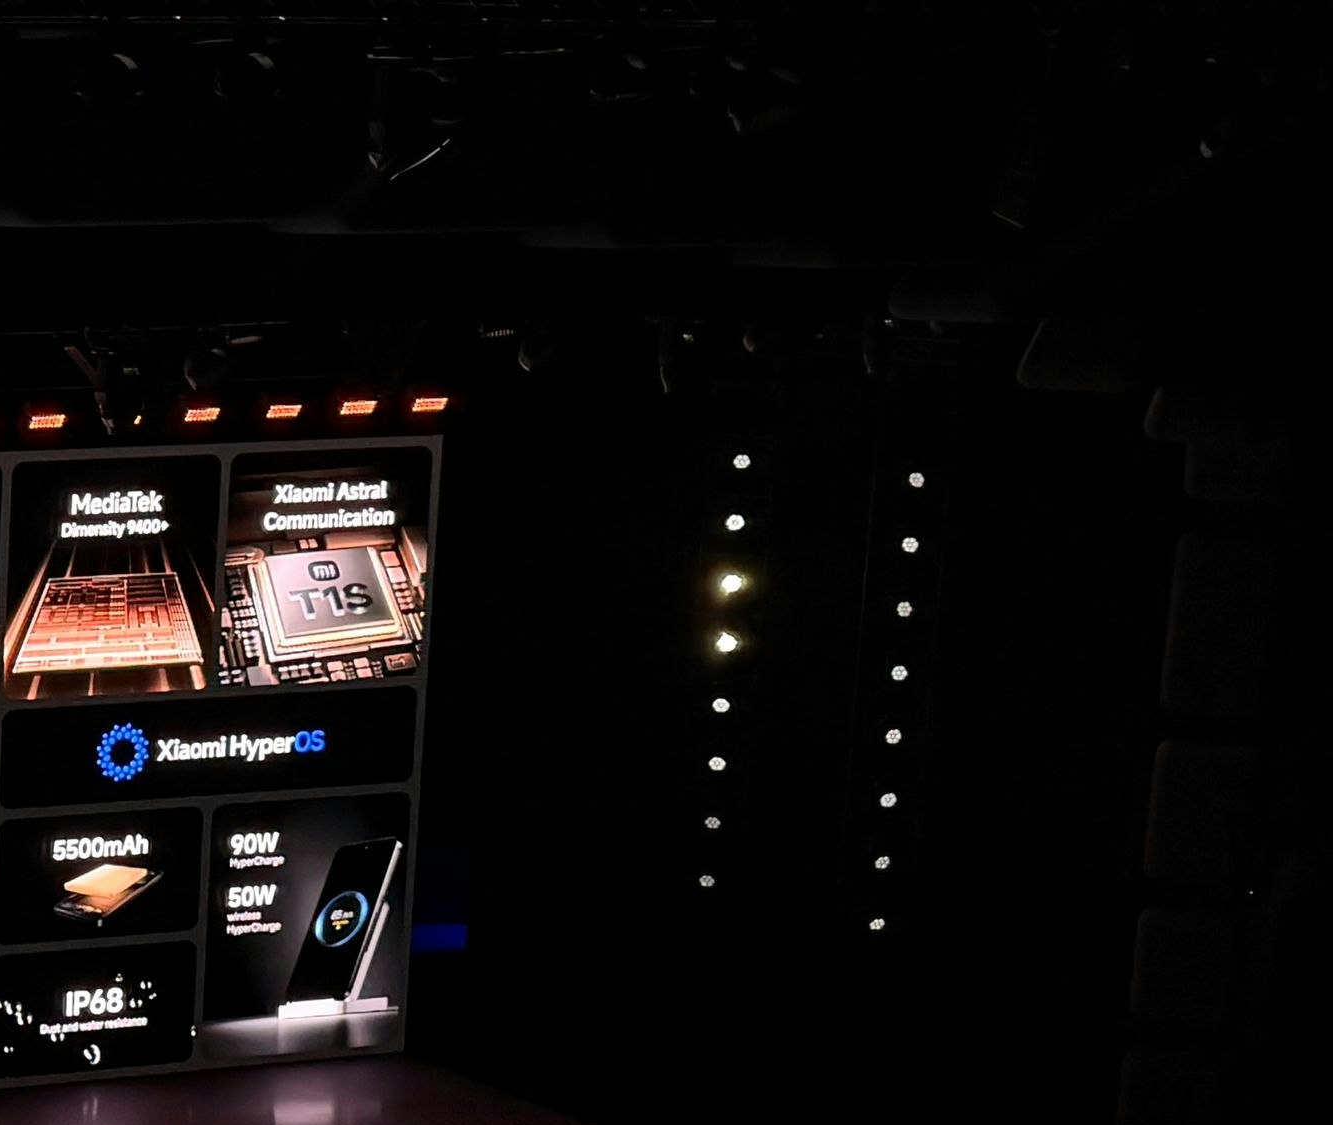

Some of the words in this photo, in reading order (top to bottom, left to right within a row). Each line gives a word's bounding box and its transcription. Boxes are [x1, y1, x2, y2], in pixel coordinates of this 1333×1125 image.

[70, 490, 163, 515] MediaTek
[274, 483, 334, 505] Xiaomi
[336, 480, 388, 501] Astral
[60, 520, 125, 538] Dimensity
[126, 518, 170, 535] 9400+
[263, 507, 396, 531] Communication
[288, 582, 374, 620] T1S
[156, 735, 227, 762] Xiaomi
[229, 730, 326, 762] HyperOS
[53, 834, 149, 861] 5500mAh
[230, 831, 280, 855] 90W
[229, 856, 285, 869] HyperCharge
[228, 884, 277, 908] 50W
[226, 922, 282, 936] HyperCharge
[66, 987, 124, 1017] IP68
